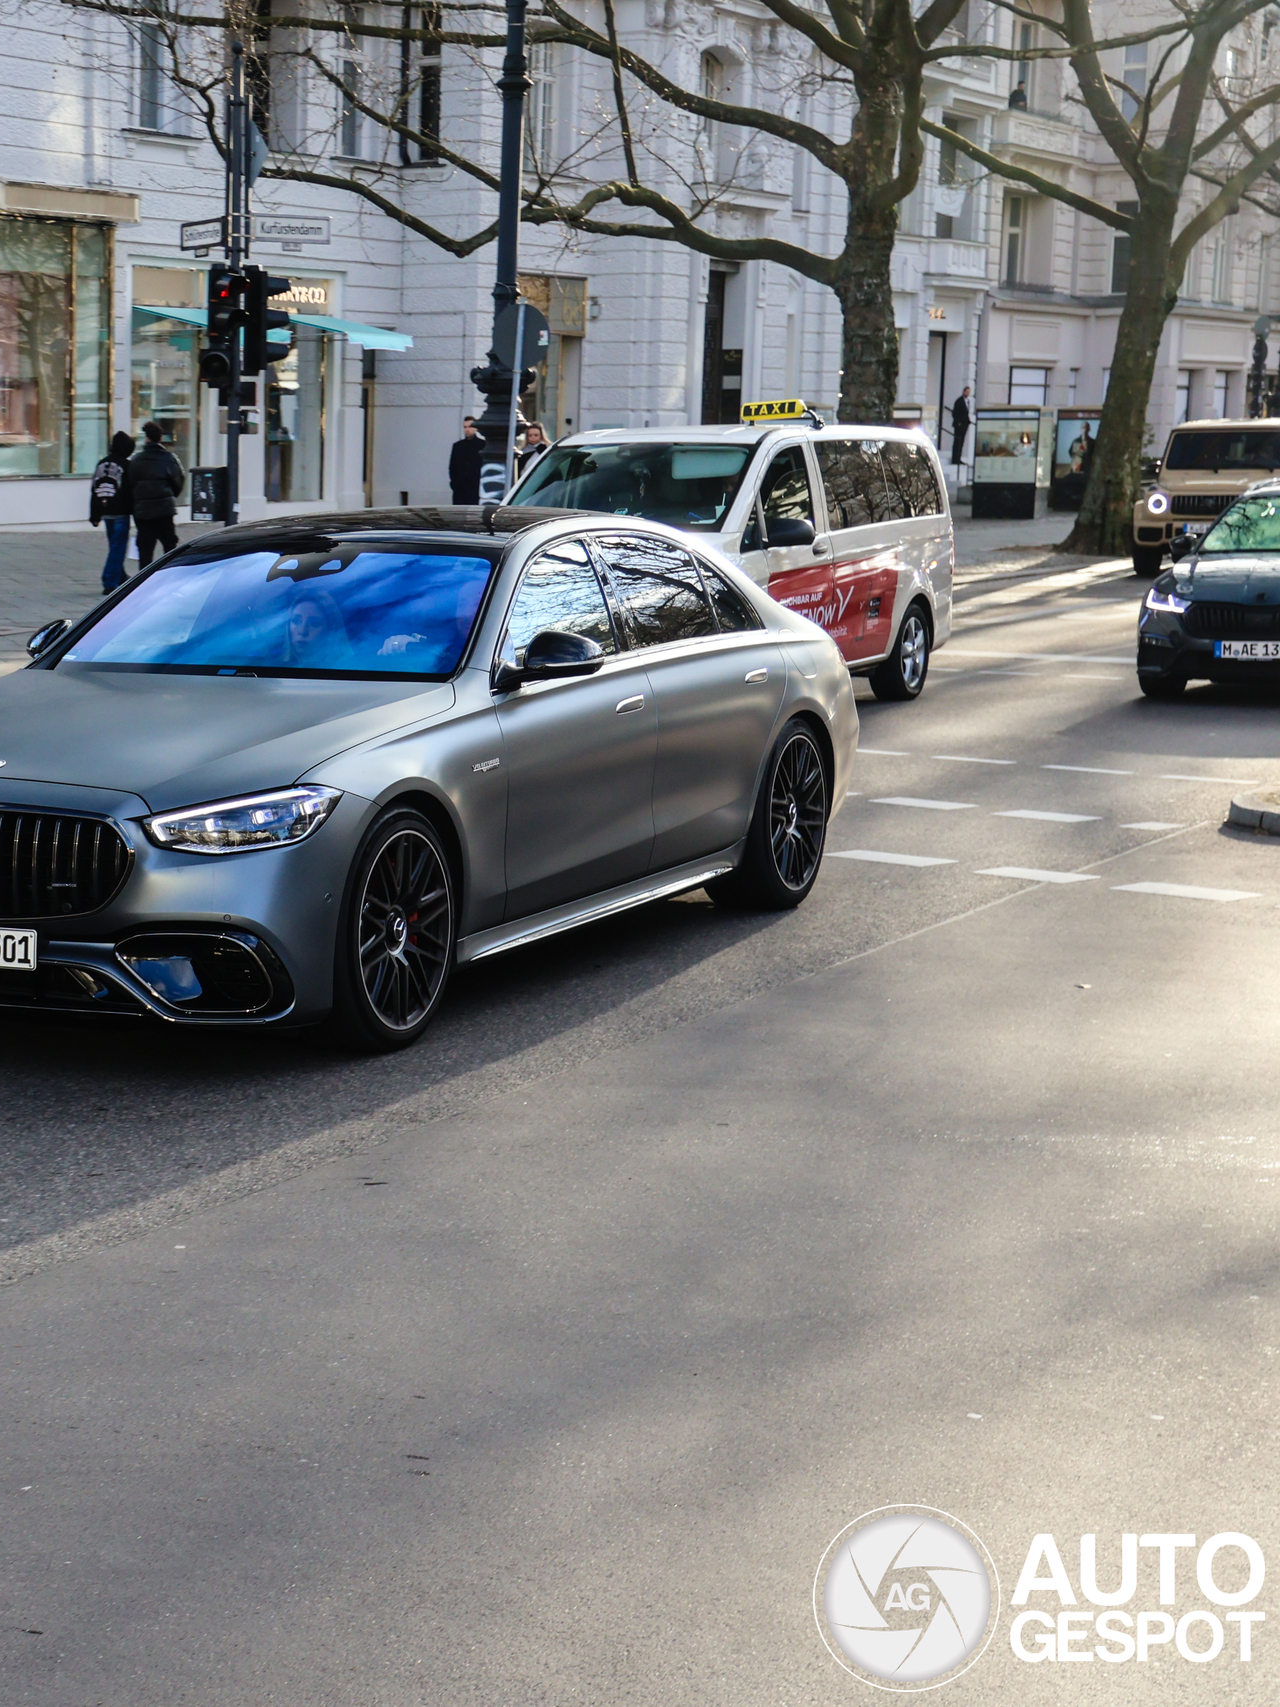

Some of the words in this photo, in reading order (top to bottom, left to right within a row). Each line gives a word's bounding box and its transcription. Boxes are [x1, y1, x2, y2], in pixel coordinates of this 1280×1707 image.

[260, 221, 323, 236] Kurfürstendamm
[750, 402, 789, 416] TAXI
[810, 592, 823, 603] AUF
[1223, 643, 1232, 656] M
[1241, 643, 1258, 657] AE
[1262, 643, 1280, 657] 13
